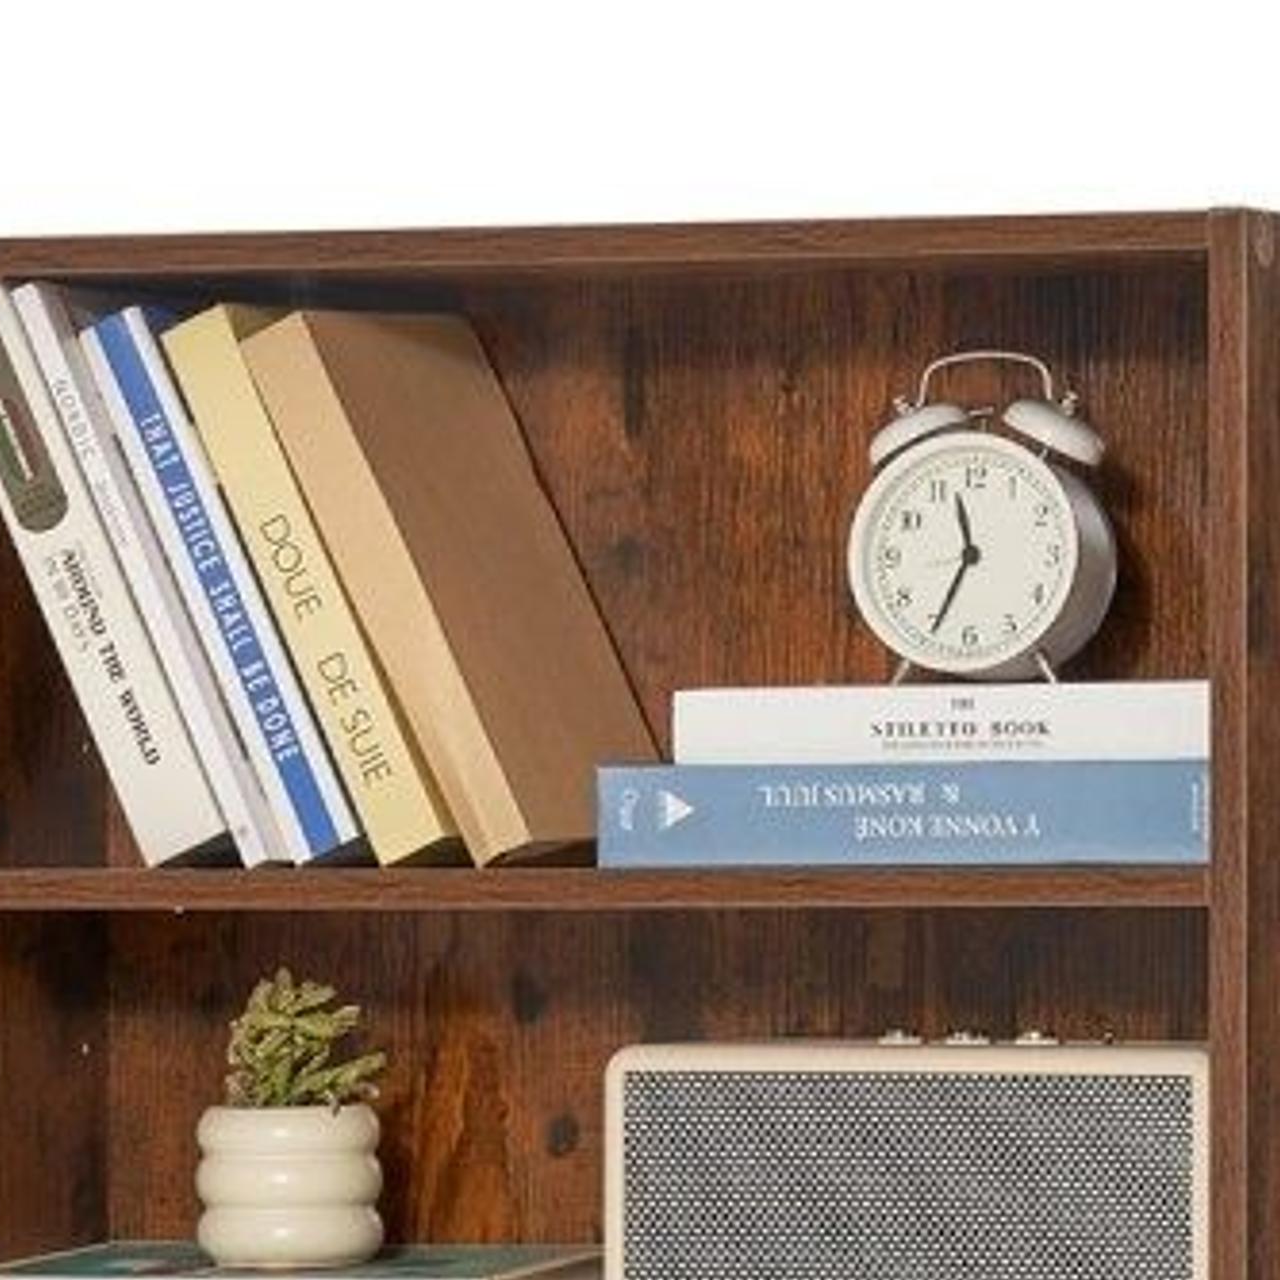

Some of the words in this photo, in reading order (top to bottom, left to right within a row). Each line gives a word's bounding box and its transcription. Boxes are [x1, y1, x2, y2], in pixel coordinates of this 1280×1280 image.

[966, 466, 987, 488] 12
[931, 480, 946, 501] 11
[1034, 505, 1048, 527] 2
[140, 413, 179, 469] THAT
[168, 483, 219, 572] JUSTICE
[209, 580, 253, 650] SHALL
[256, 698, 299, 761] DONE
[962, 625, 979, 646] 6
[62, 549, 107, 636] AROUND
[98, 641, 125, 684] THE
[118, 688, 160, 765] WORLD
[317, 652, 357, 705] DE
[340, 709, 392, 781] SUIE
[870, 721, 978, 737] STILETTO
[991, 720, 1051, 736] BOOK
[756, 783, 819, 806] JUUL
[824, 782, 926, 805] RASMUS
[941, 782, 960, 802] &
